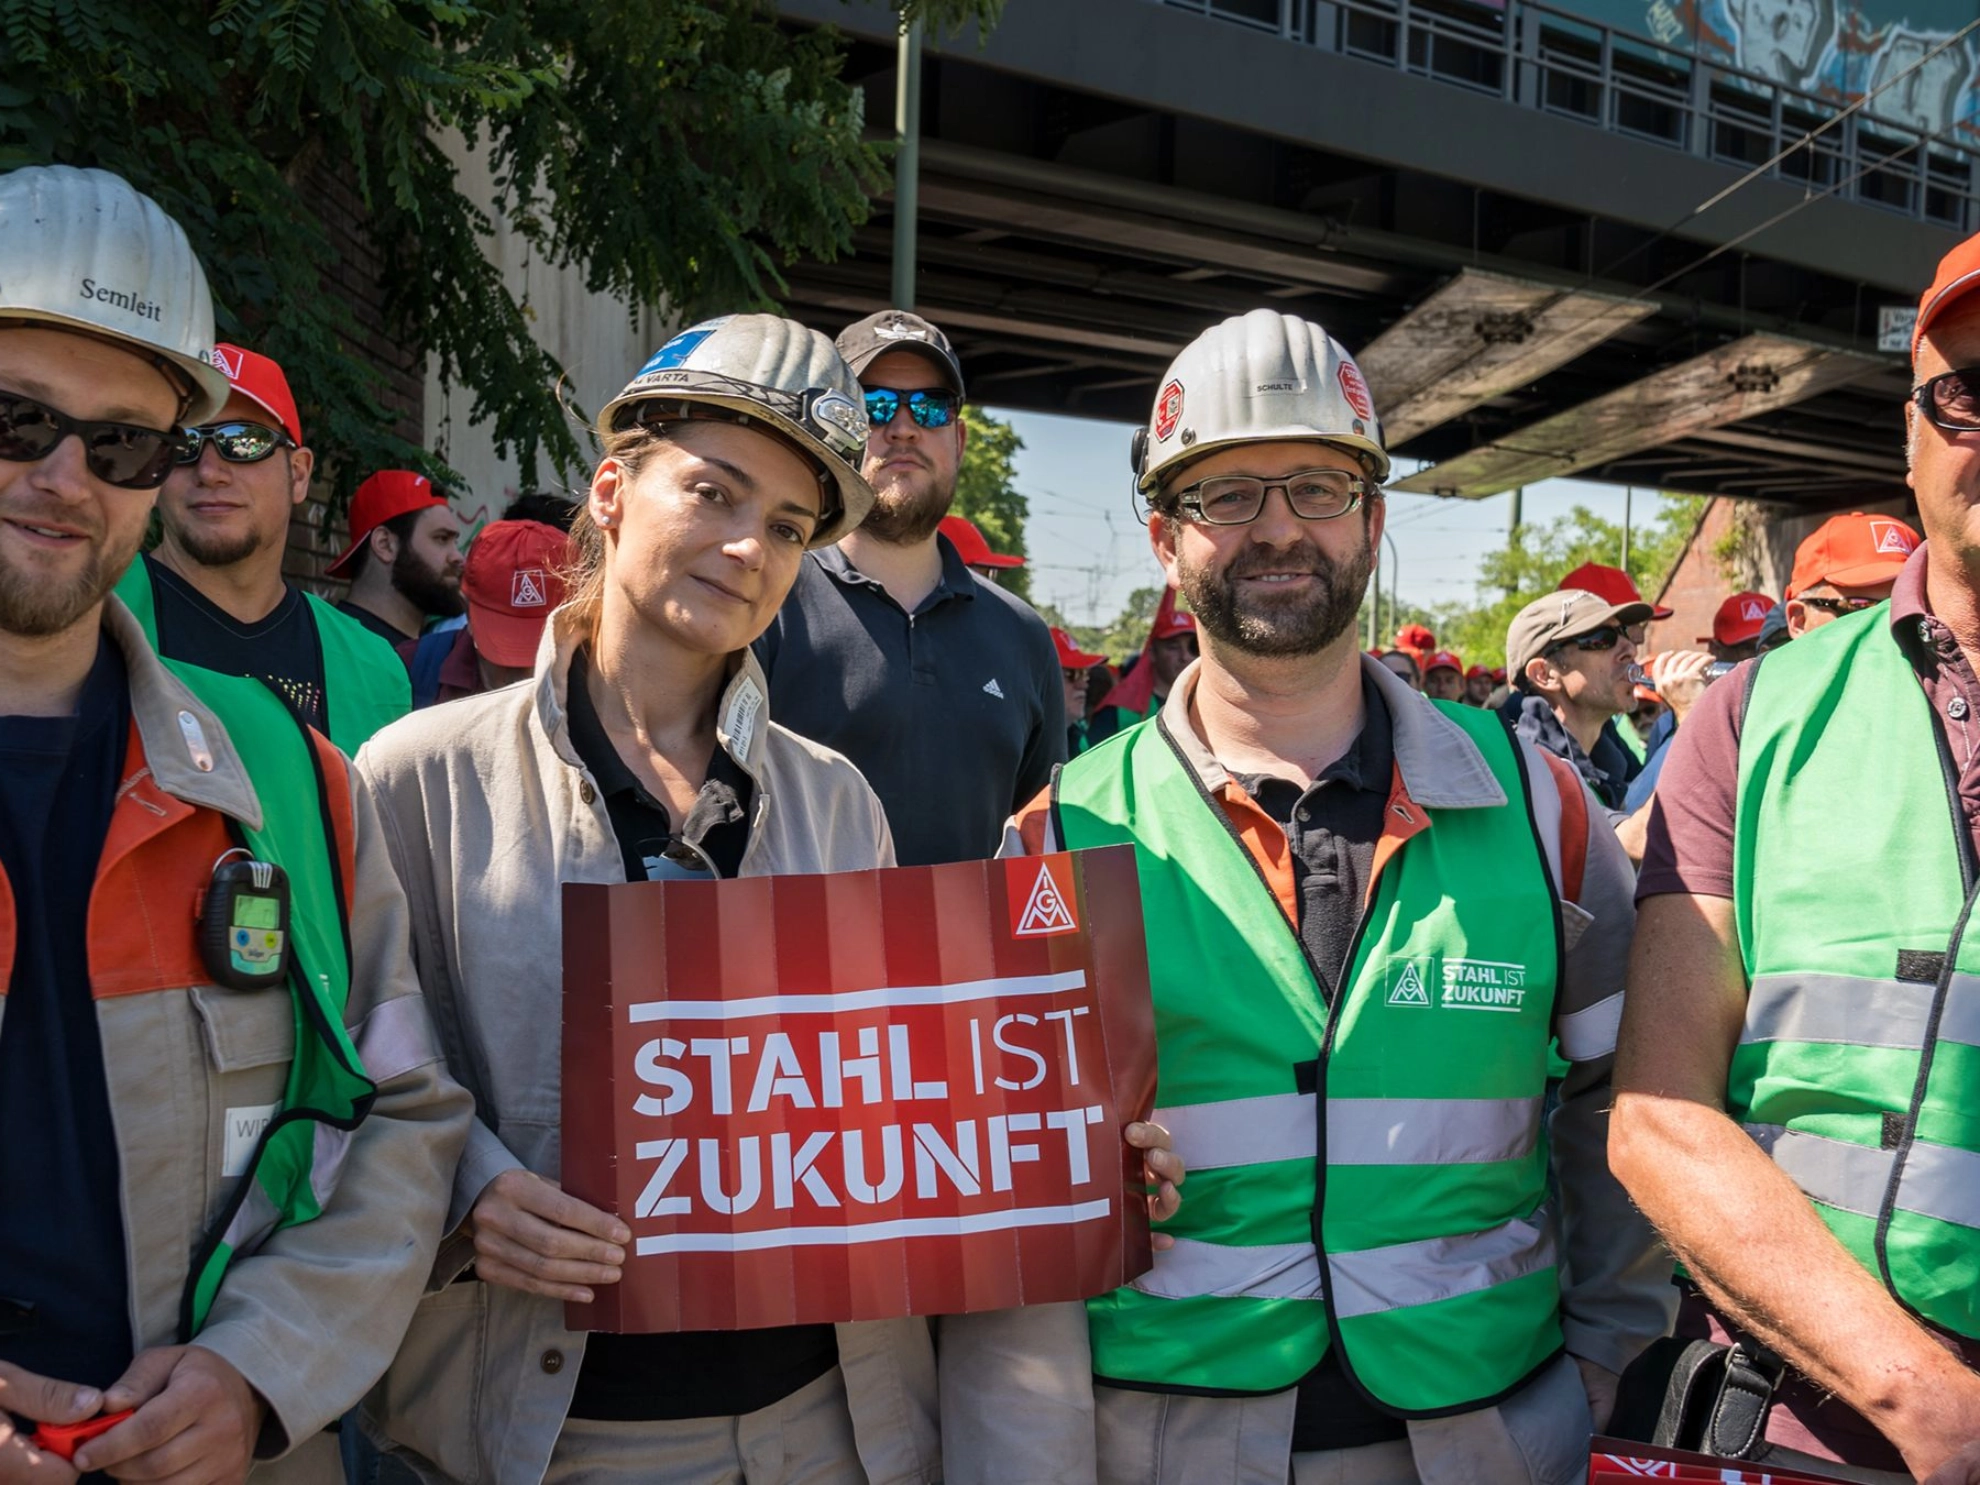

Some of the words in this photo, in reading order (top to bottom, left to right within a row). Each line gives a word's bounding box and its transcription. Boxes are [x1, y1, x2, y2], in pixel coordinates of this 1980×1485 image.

[80, 278, 161, 322] Semleit
[647, 373, 689, 384] VARTA
[1257, 383, 1293, 392] SCHULTE
[1442, 965, 1502, 985] STAHL
[1503, 969, 1526, 987] IST
[1441, 984, 1526, 1006] ZUKUNFT
[633, 1024, 949, 1117] STAHL
[969, 1005, 1091, 1096] IST
[635, 1105, 1105, 1219] ZUKUNFT
